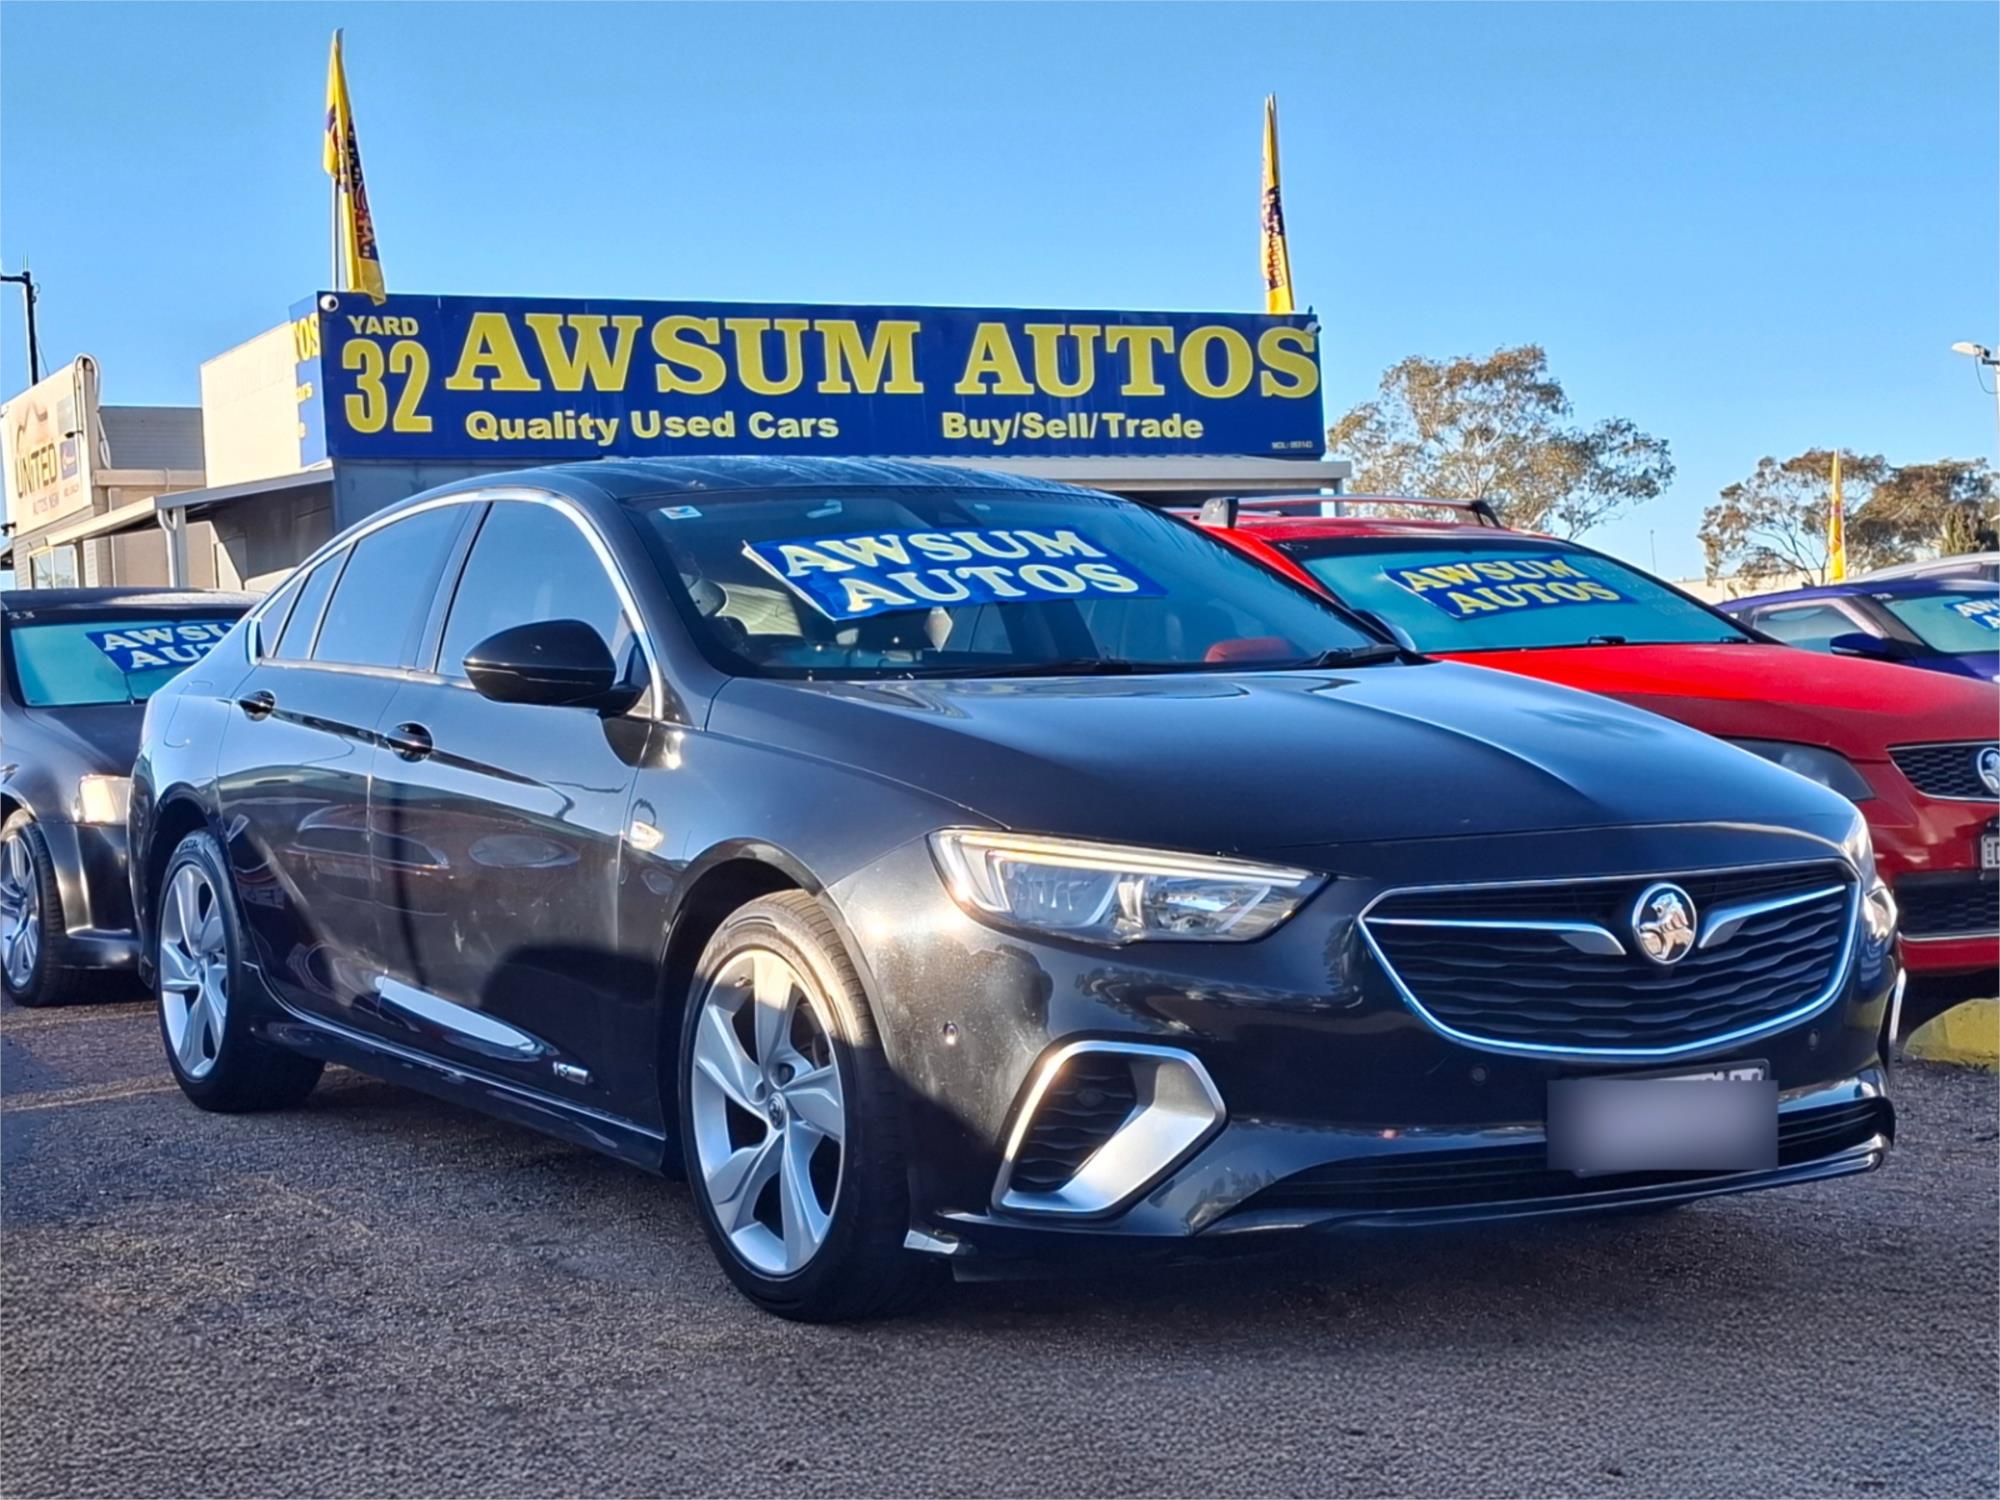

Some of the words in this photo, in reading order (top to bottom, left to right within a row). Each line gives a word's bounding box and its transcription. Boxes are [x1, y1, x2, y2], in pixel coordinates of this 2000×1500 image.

[347, 315, 419, 336] YARD
[444, 311, 925, 396] AWSUM
[954, 322, 1320, 399] AUTOS
[341, 338, 433, 434] 32
[465, 409, 619, 447] Quality
[630, 410, 736, 439] Used
[748, 411, 839, 439] Cars
[778, 530, 1107, 577] AWSUM
[838, 562, 1140, 611] AUTOS
[1400, 559, 1589, 592] AWSUM
[1447, 581, 1621, 614] AUTOS
